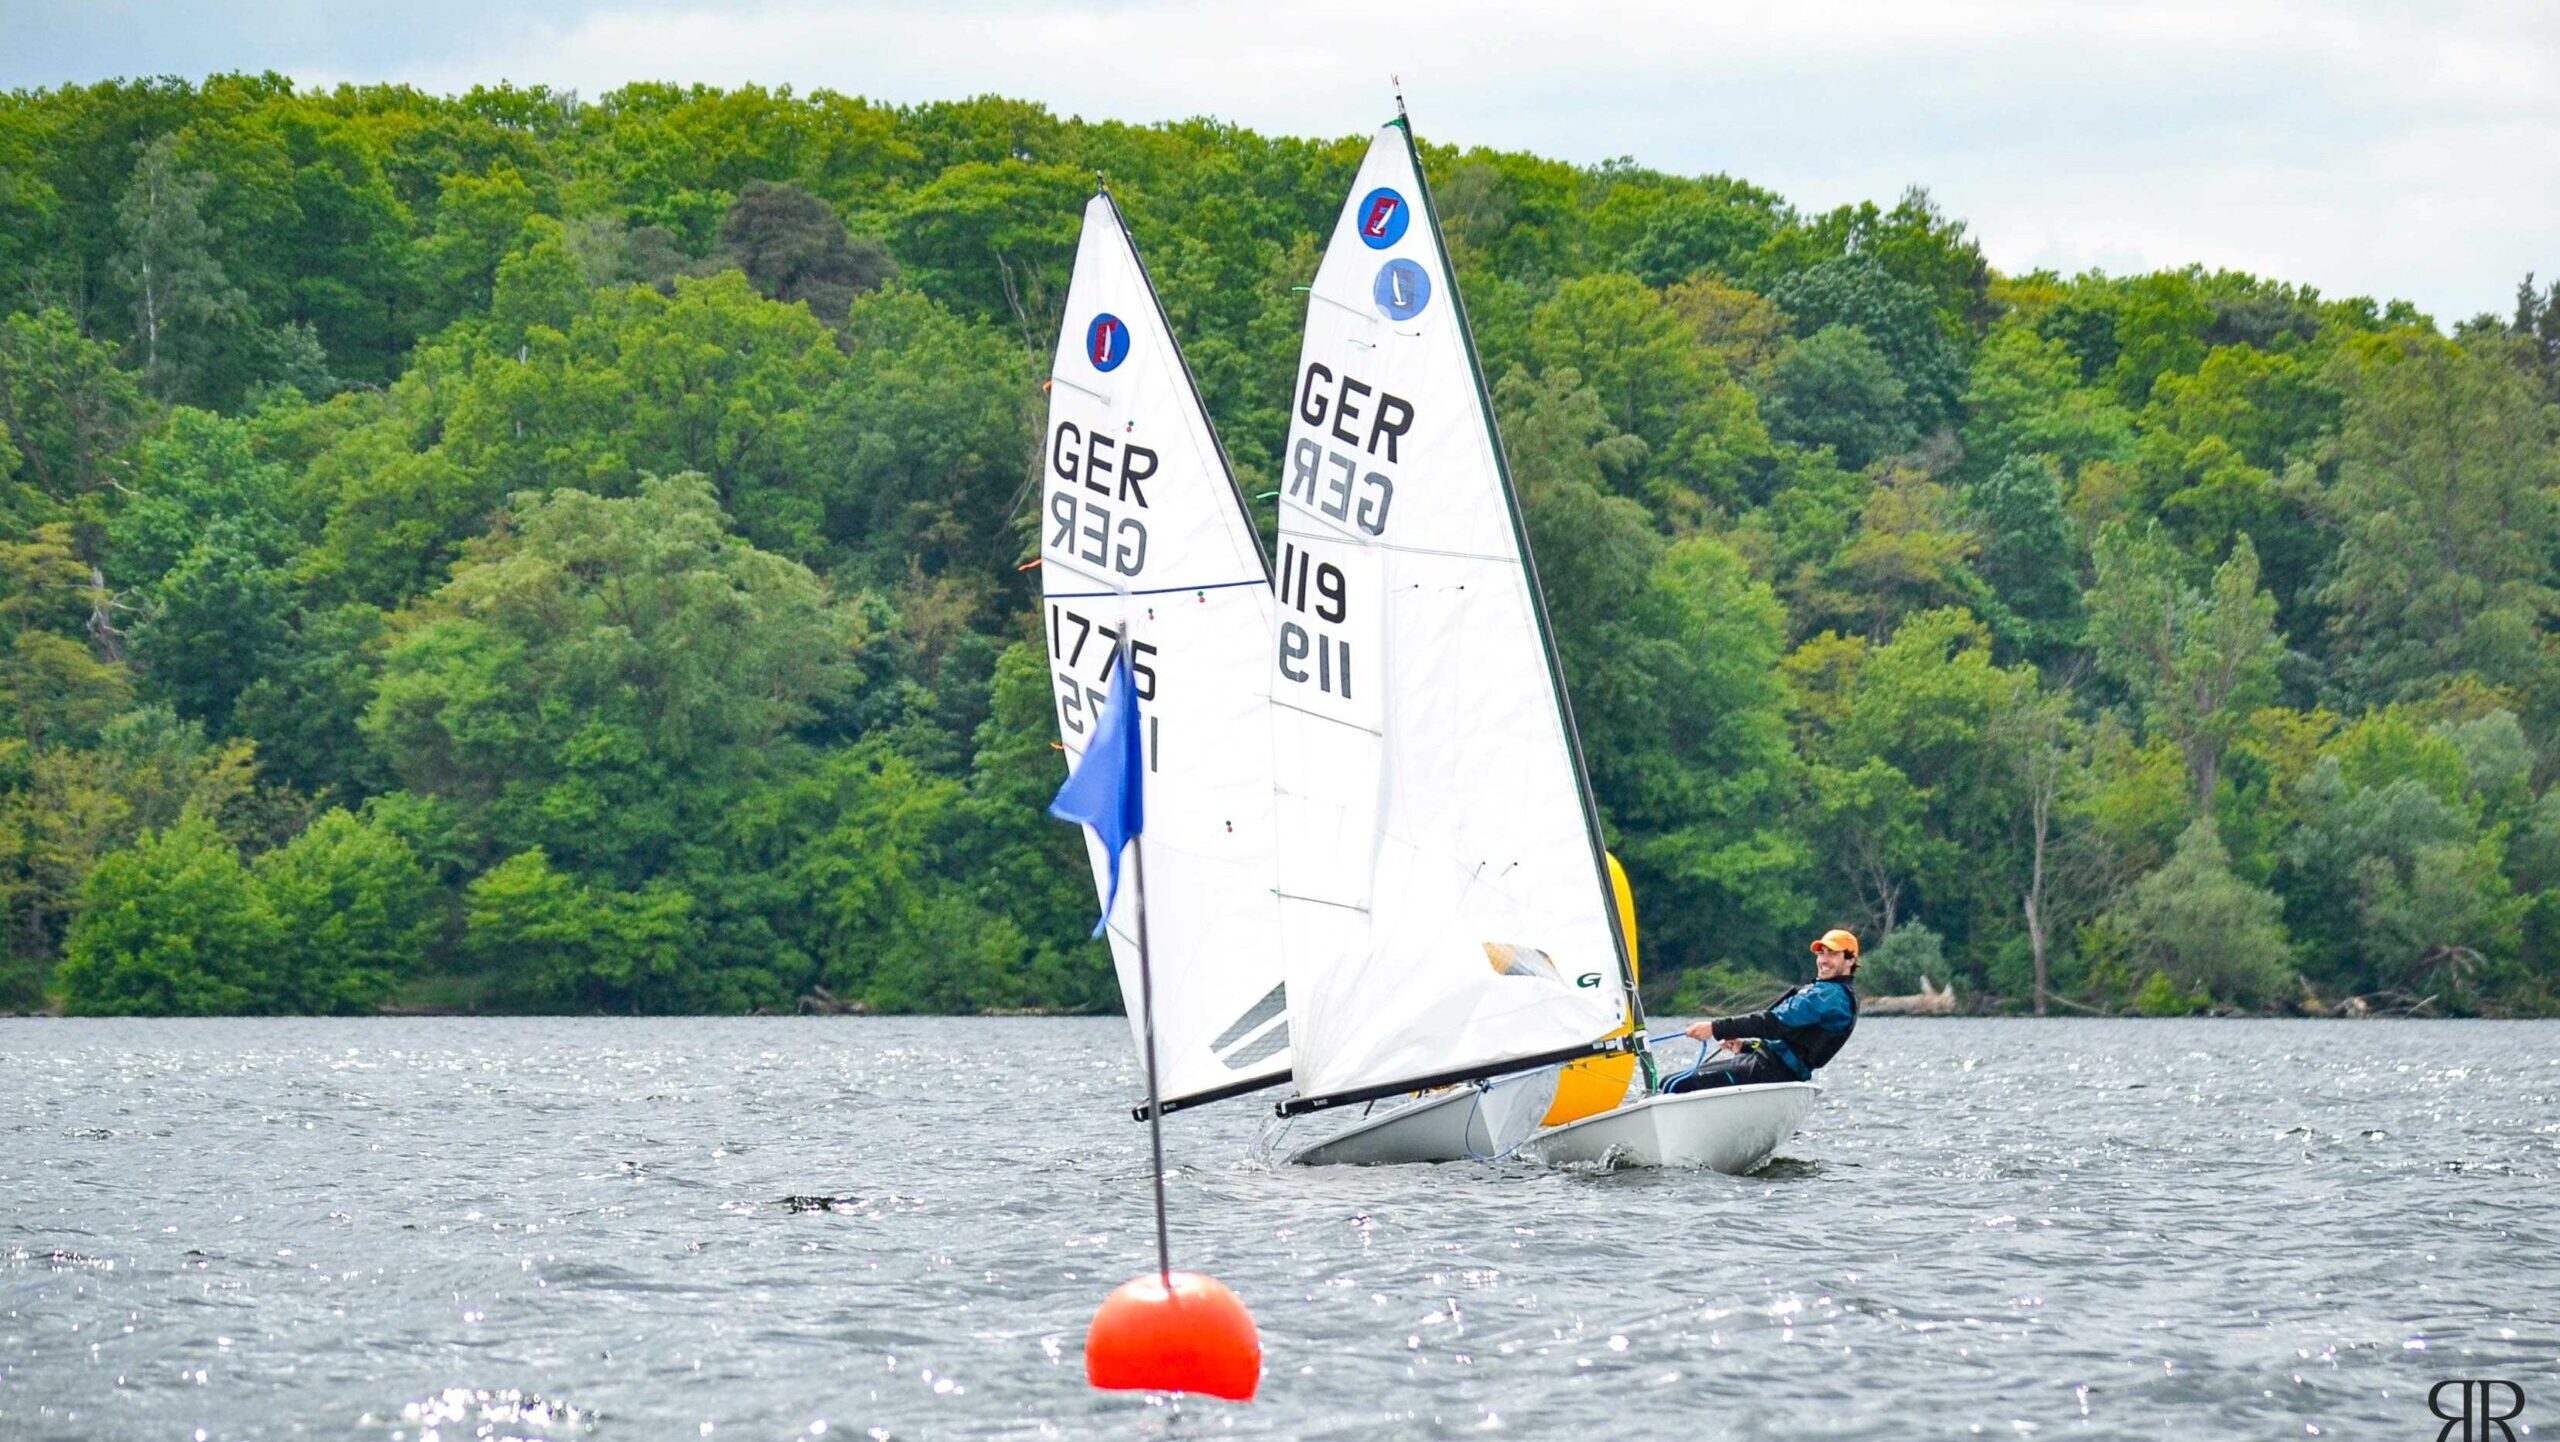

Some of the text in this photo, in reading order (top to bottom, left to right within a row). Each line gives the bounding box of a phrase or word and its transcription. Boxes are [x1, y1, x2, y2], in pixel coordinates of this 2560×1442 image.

[1299, 362, 1415, 464] GER
[1053, 421, 1159, 509] GER
[1281, 542, 1346, 624] 119
